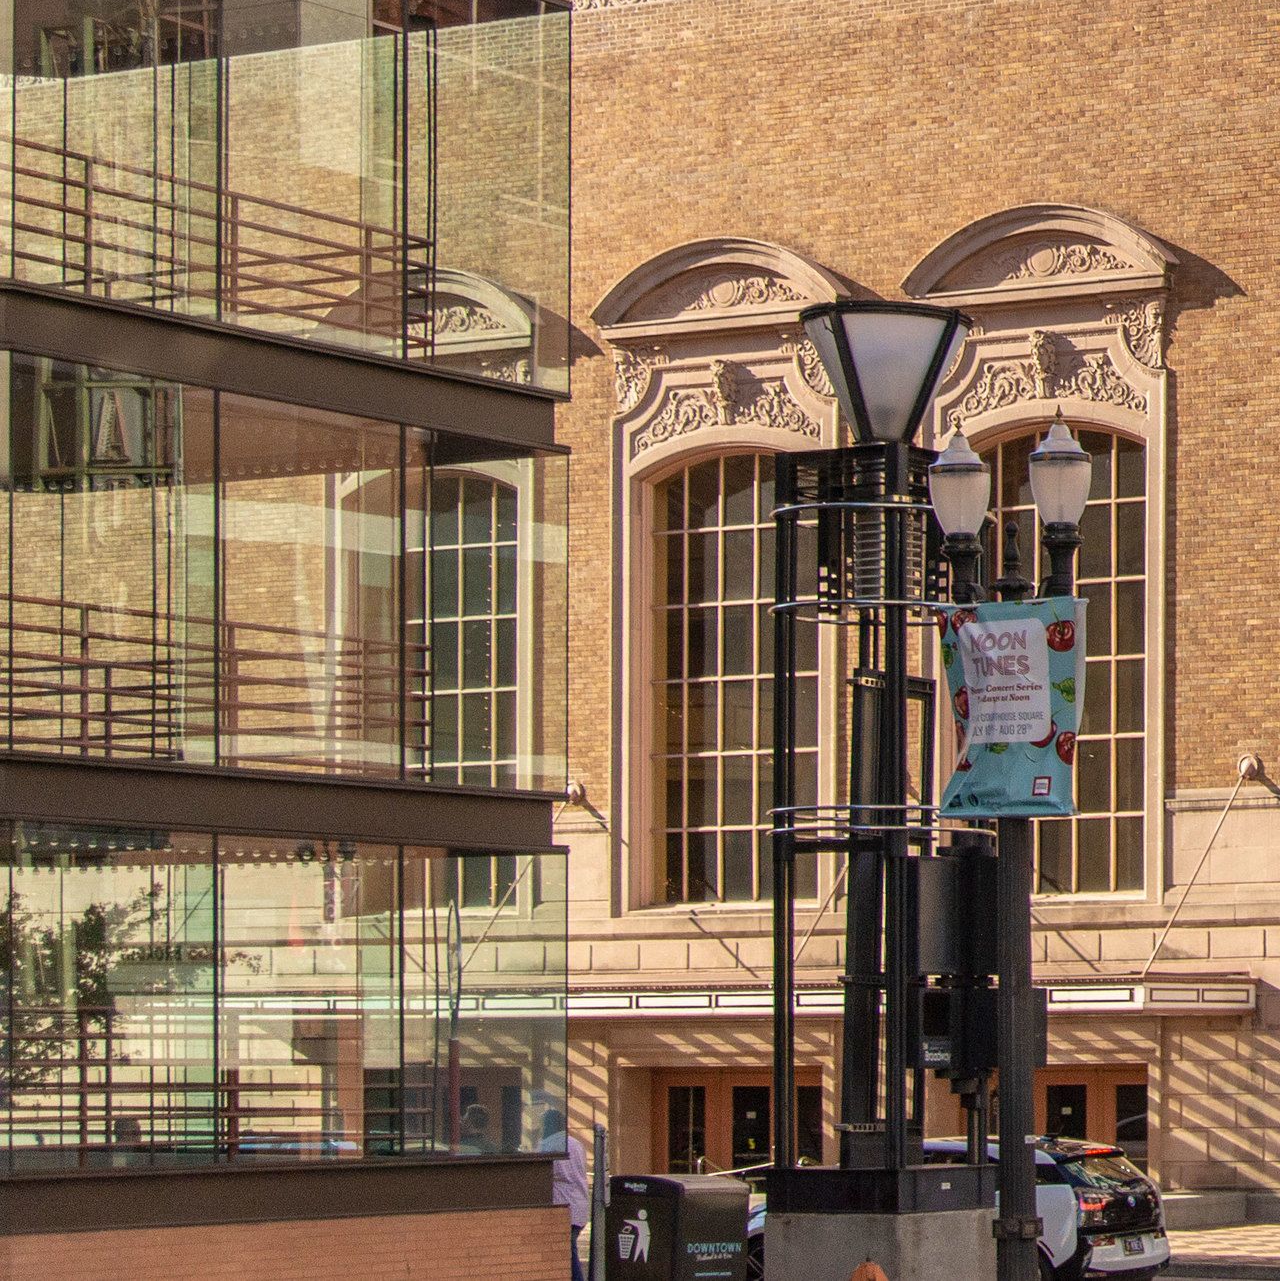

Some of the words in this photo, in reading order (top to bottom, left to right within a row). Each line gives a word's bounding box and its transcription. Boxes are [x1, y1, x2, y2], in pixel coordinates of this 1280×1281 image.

[970, 630, 1027, 653] NOON
[972, 655, 1030, 677] TUNES
[986, 684, 1014, 692] Concert
[1016, 682, 1042, 691] Series
[1009, 694, 1030, 702] Noon
[1018, 711, 1044, 721] SQUARE
[999, 725, 1014, 735] AUG
[687, 1243, 742, 1254] DOWNTOWN
